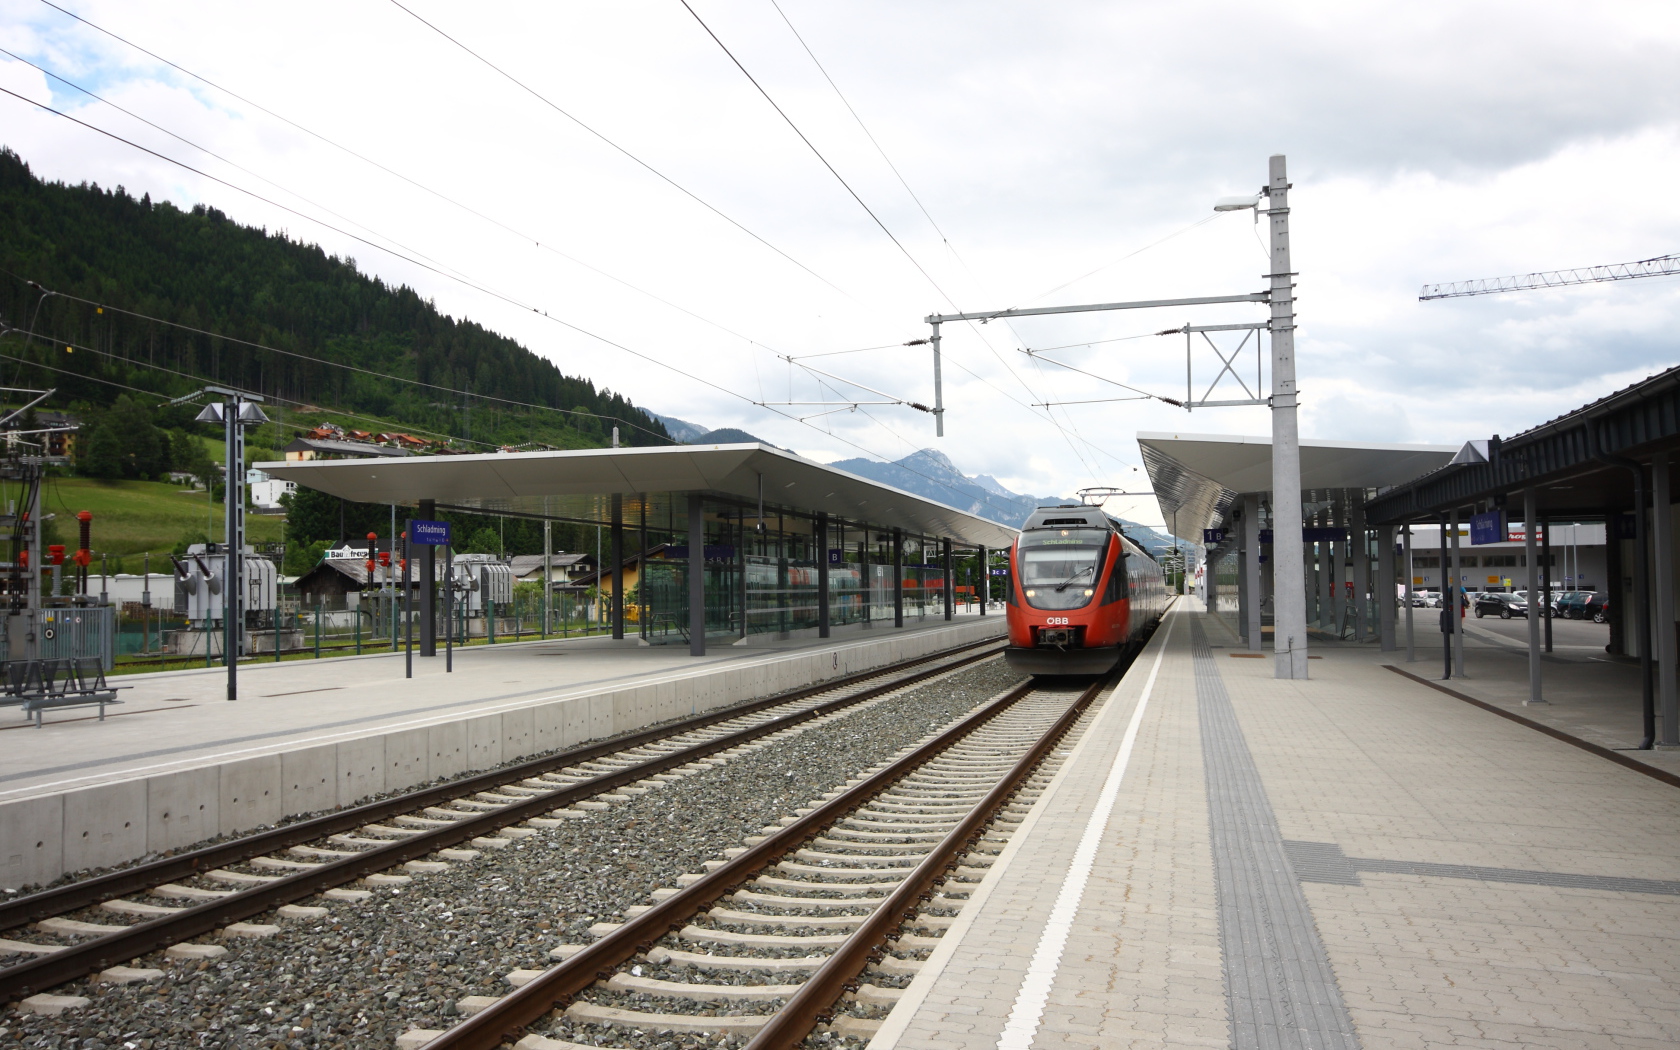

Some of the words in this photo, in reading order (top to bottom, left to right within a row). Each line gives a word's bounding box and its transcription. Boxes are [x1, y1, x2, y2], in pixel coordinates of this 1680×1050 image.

[416, 524, 446, 536] Schladming
[1208, 531, 1212, 540] 1
[1046, 617, 1069, 625] ÖBB
